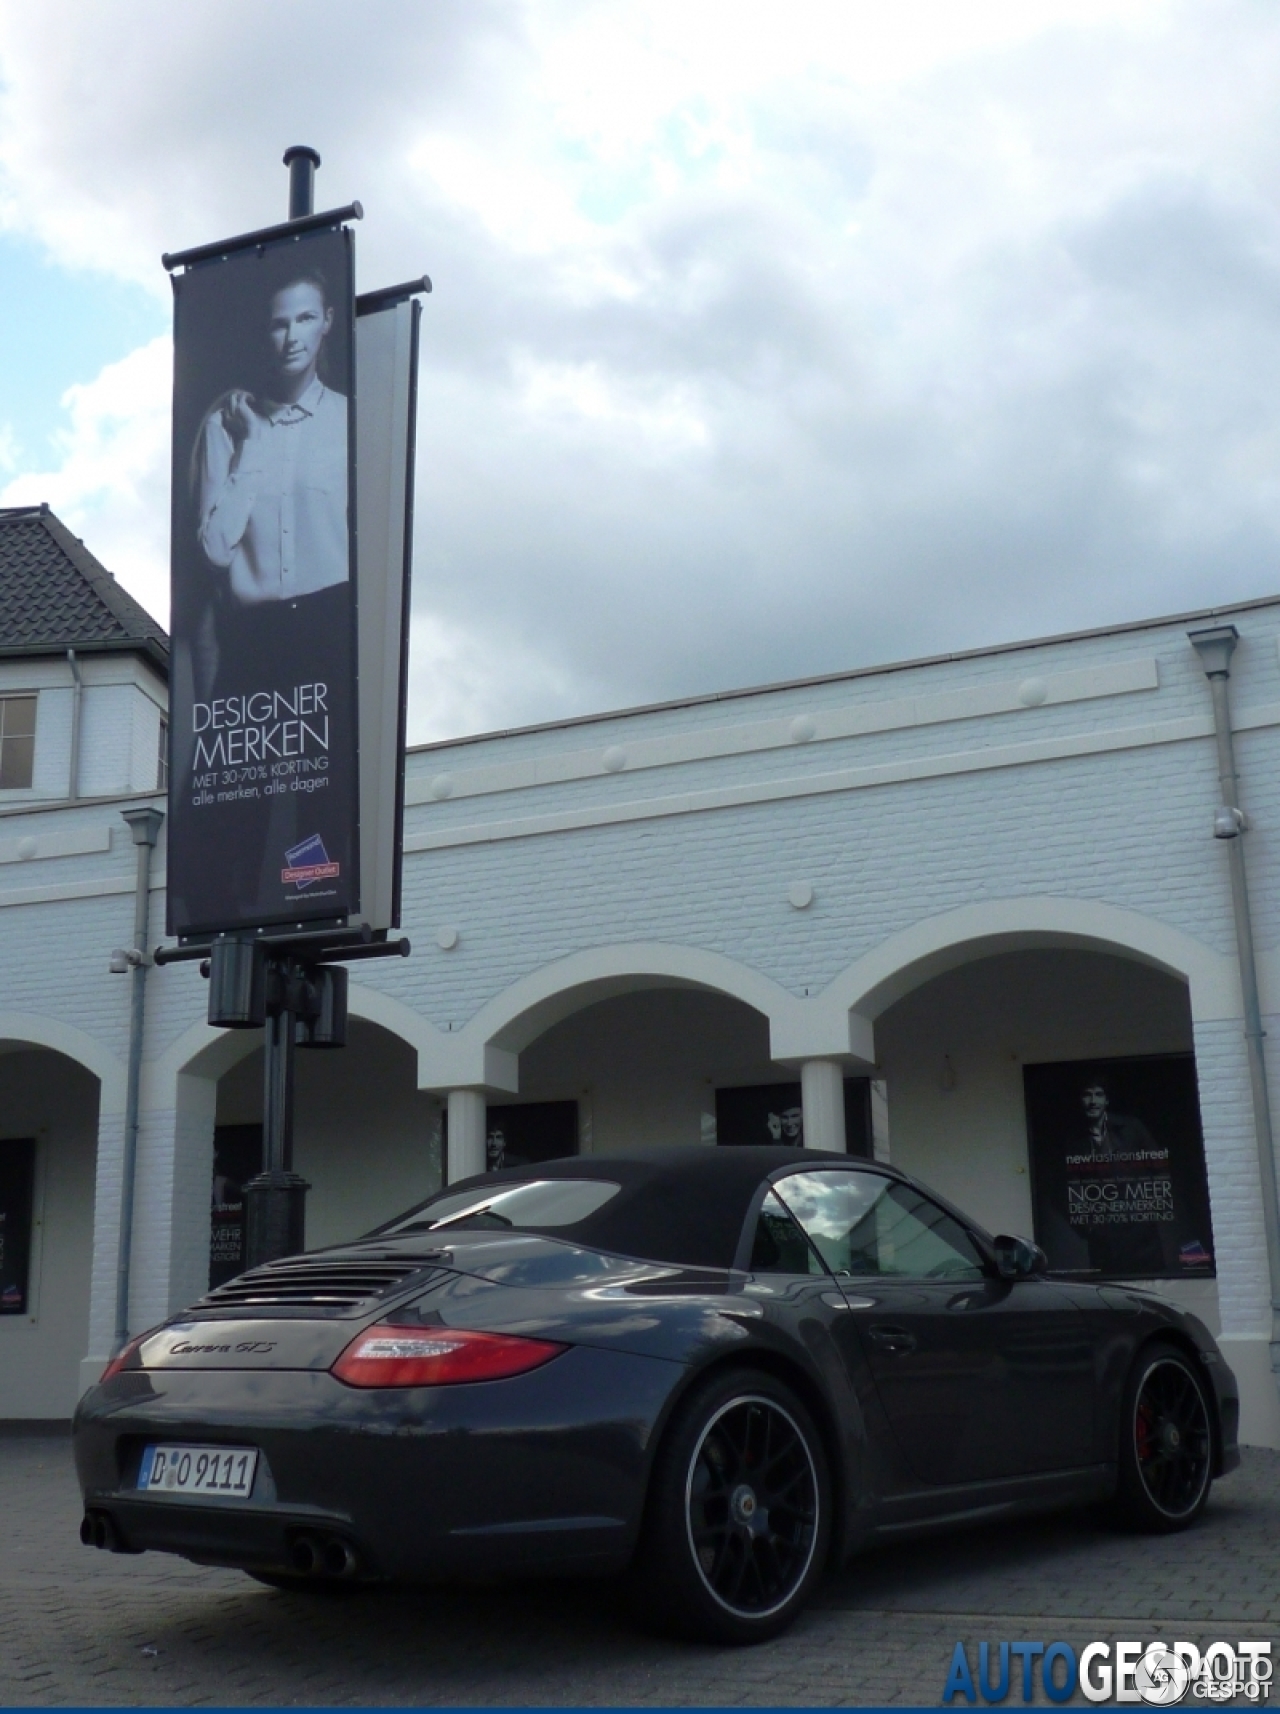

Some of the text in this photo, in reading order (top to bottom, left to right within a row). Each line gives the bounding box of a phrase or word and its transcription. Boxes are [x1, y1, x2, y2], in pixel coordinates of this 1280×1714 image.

[192, 682, 329, 733] DESIGNER
[192, 714, 329, 771] MERKEN
[192, 756, 329, 789] MET 30-70% KORTING
[192, 774, 329, 806] alle merken, alle dagen
[1069, 1181, 1172, 1202] NOG MEER
[1069, 1199, 1174, 1215] DESIGNERMERKEN
[1069, 1213, 1089, 1225] MET
[1130, 1210, 1175, 1223] KORTING
[169, 1340, 231, 1355] Carrera
[195, 1453, 249, 1489] 9111
